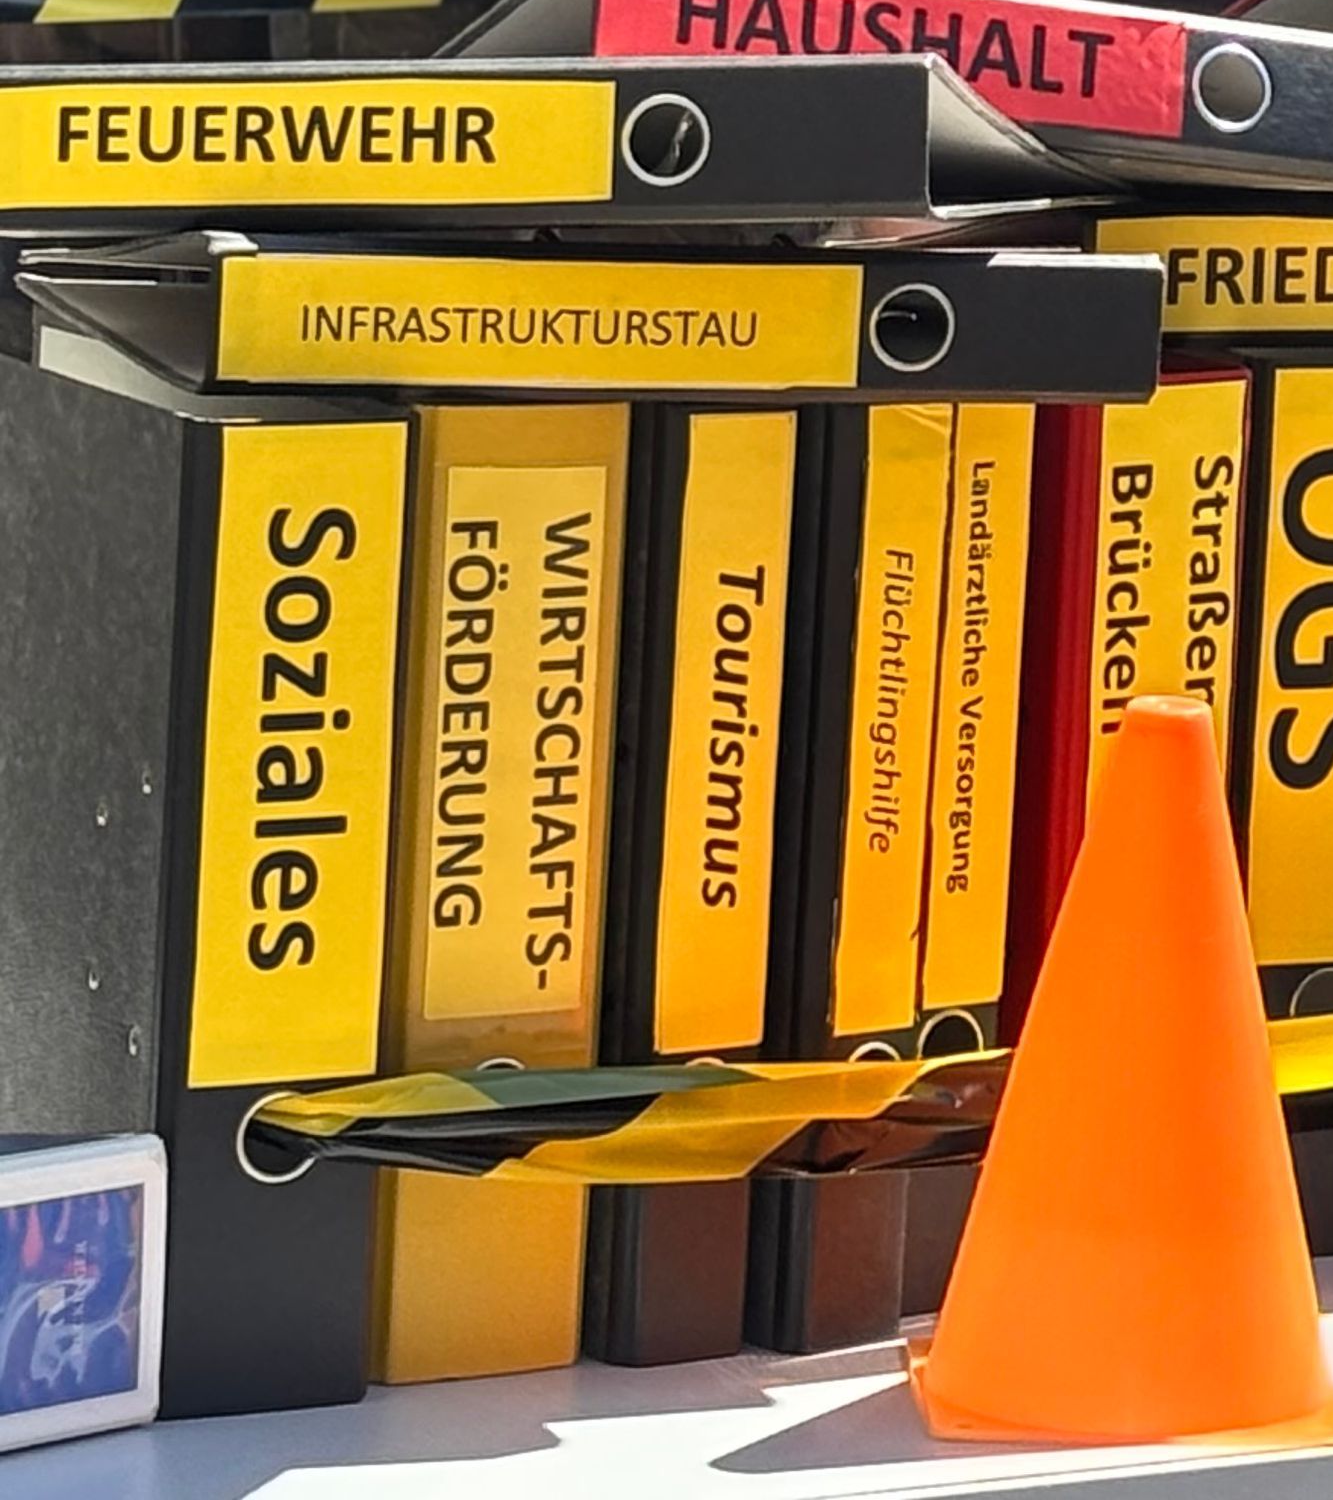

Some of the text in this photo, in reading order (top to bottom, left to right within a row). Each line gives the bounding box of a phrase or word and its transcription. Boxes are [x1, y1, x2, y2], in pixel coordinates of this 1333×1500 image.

[57, 104, 497, 165] FEUERWEHR
[301, 304, 760, 349] INFRASTRUKTURSTAU
[248, 506, 358, 973] Soziales
[433, 518, 509, 930] FÖRDERUNG
[524, 510, 593, 993] WIRTSCHAFTS-
[701, 564, 766, 910] Tourismus
[867, 547, 914, 854] Flüchtlingshilfe
[946, 459, 997, 895] Landärztliche Versorgung
[1185, 454, 1234, 708] Straßen
